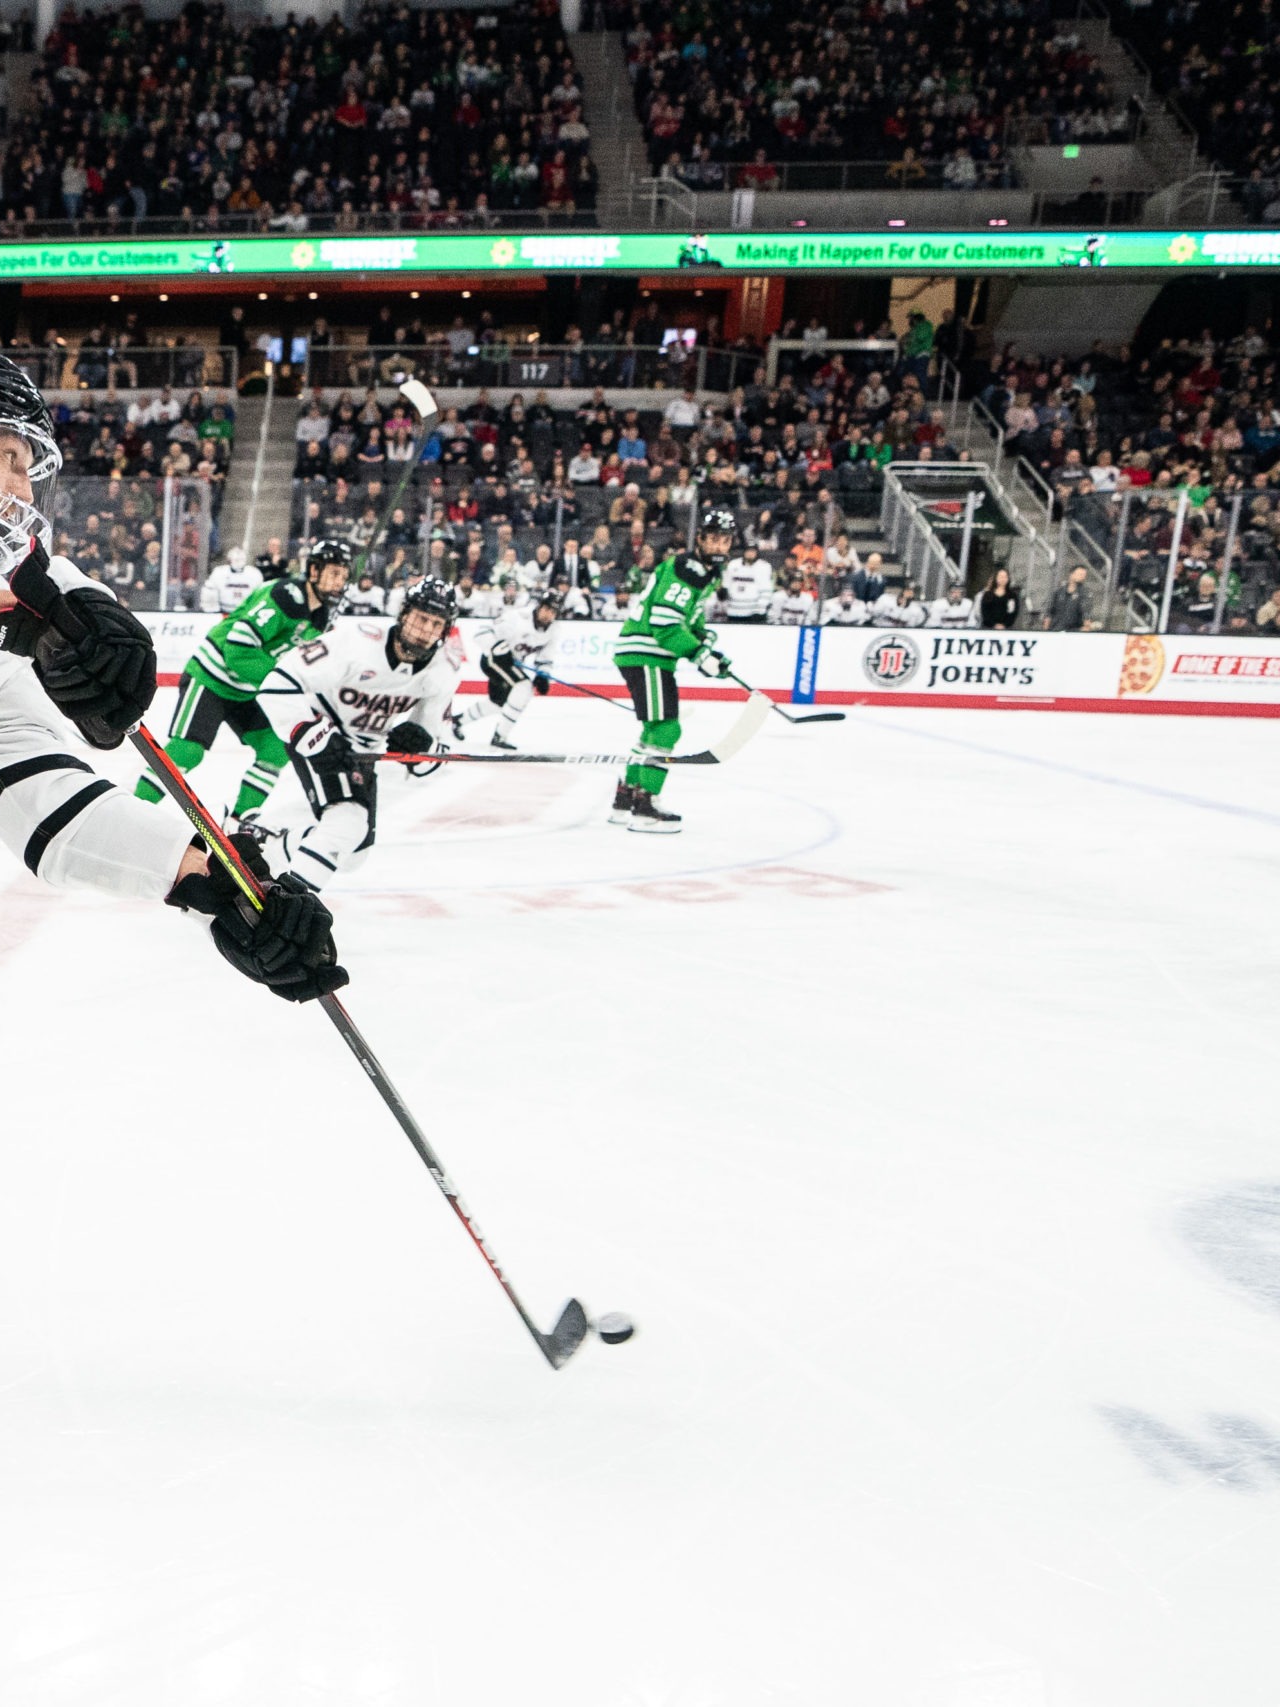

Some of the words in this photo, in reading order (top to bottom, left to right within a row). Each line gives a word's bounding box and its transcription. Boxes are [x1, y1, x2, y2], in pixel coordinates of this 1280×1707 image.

[40, 251, 64, 267] For
[69, 250, 94, 267] Our
[97, 250, 179, 267] Customers
[735, 242, 798, 265] Making
[802, 243, 815, 260] It
[819, 242, 883, 266] Happen
[888, 242, 915, 260] For
[920, 242, 949, 260] Our
[953, 242, 1045, 260] Customers
[521, 362, 549, 380] 117
[664, 582, 692, 608] 22
[248, 600, 276, 628] 14
[930, 637, 1038, 660] JIMMY
[927, 665, 1035, 688] JOHN'S
[349, 711, 393, 733] 40
